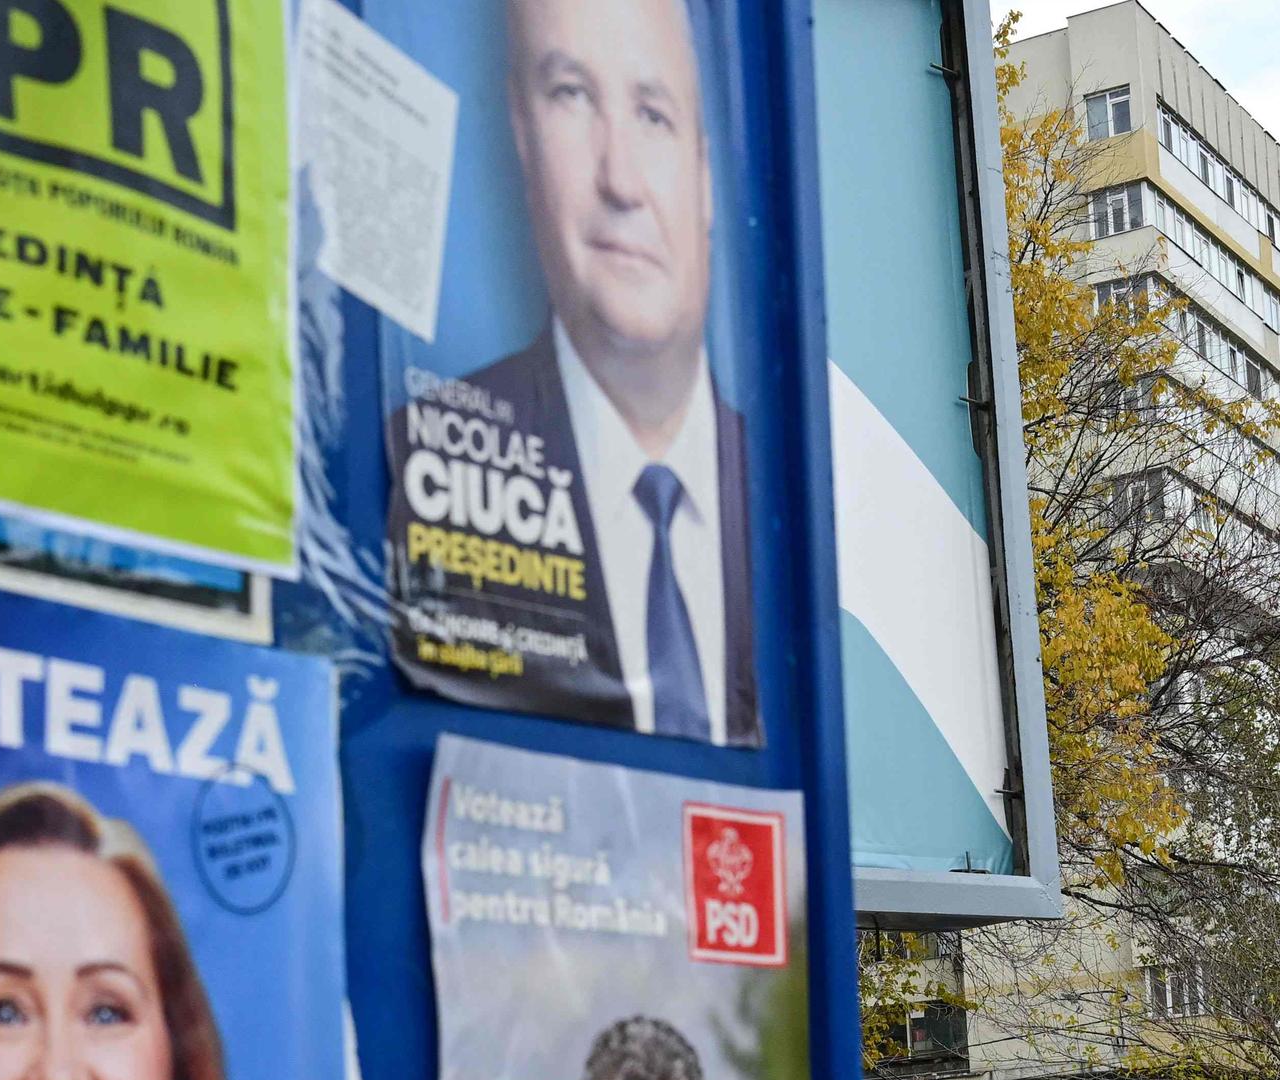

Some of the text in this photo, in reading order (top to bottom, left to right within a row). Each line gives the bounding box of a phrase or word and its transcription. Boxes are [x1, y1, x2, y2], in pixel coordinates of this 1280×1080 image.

[406, 400, 546, 481] NICOLAE
[404, 448, 586, 557] CIUCĂ
[406, 521, 587, 601] PREȘEDINTE
[452, 783, 565, 834] Votează
[552, 892, 669, 938] România
[705, 902, 758, 948] PSD
